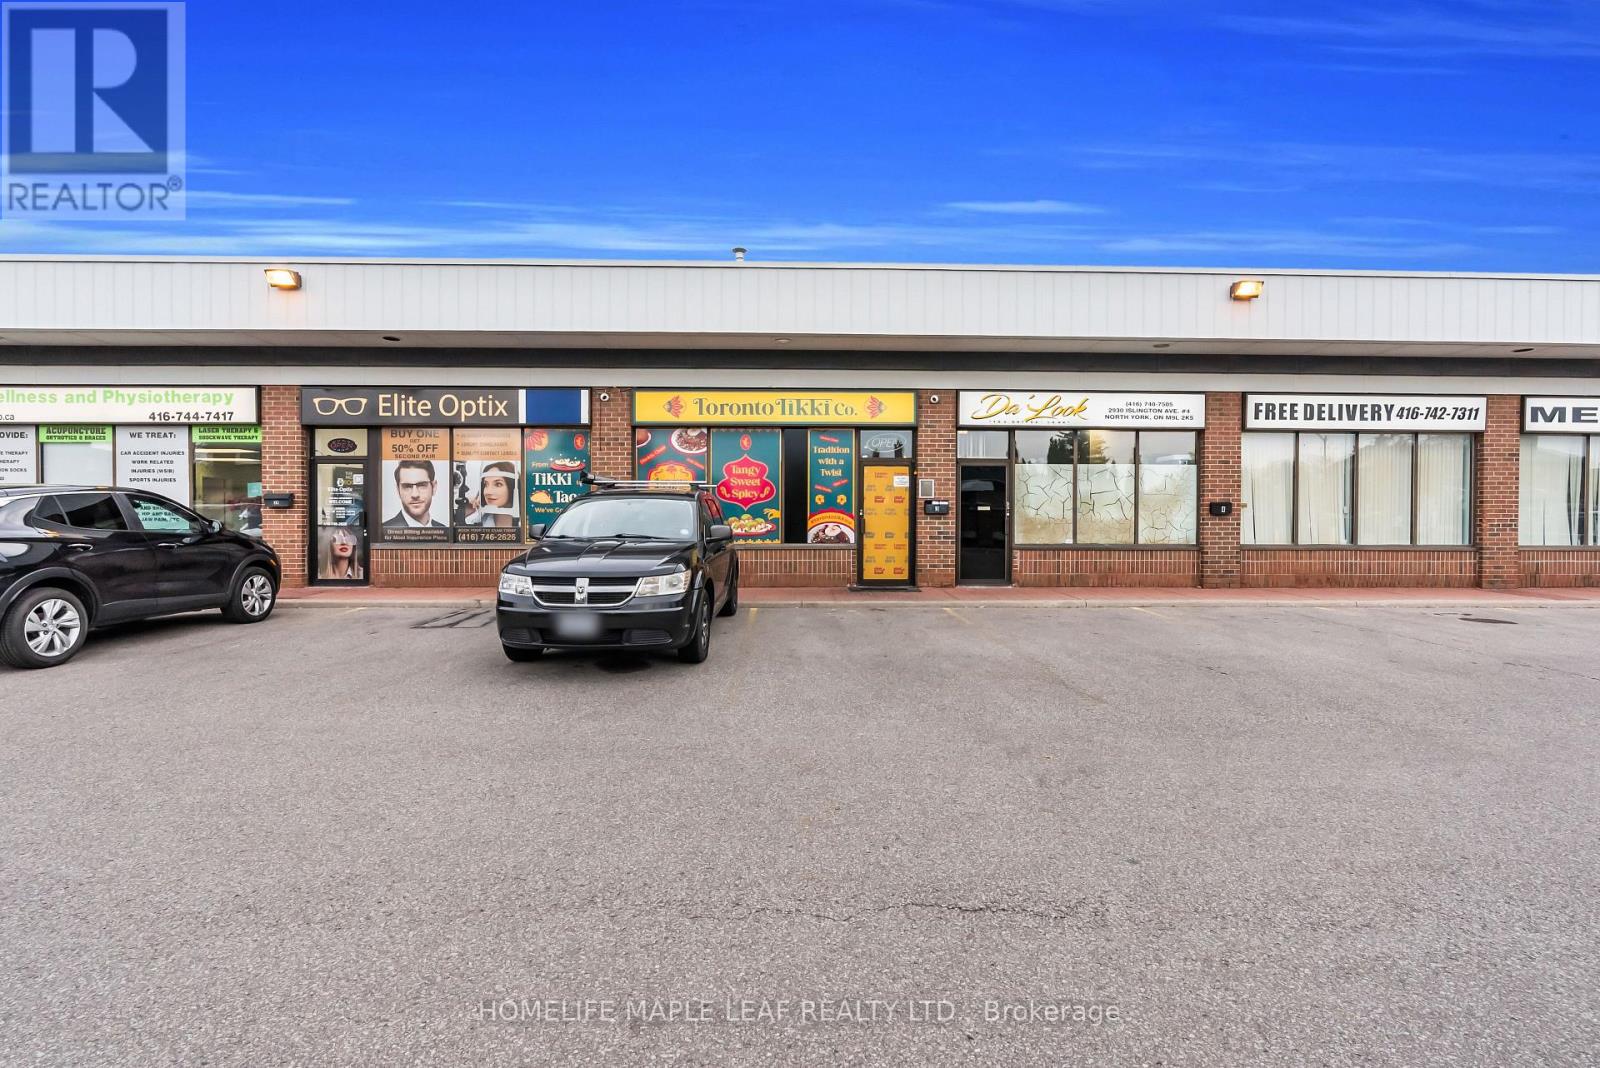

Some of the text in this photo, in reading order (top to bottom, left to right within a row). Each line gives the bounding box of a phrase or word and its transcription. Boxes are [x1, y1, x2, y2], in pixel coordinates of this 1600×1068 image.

[65, 390, 97, 404] and
[103, 390, 234, 406] Physiotherapy
[378, 393, 508, 422] Elite Optix
[693, 398, 858, 416] Toronto Tikki Co.
[1253, 402, 1480, 421] FREE DELIVERY 416-742-7311
[148, 411, 234, 421] 416-744-7417
[1530, 406, 1599, 423] ME
[46, 427, 106, 435] ACUPUNCTURE
[390, 429, 440, 438] BUY ONE
[391, 444, 439, 452] 50% OFF
[871, 438, 901, 448] OPE
[818, 457, 837, 465] with
[730, 477, 761, 486] Sweet
[731, 489, 759, 500] Spicy
[458, 533, 478, 541] (416)
